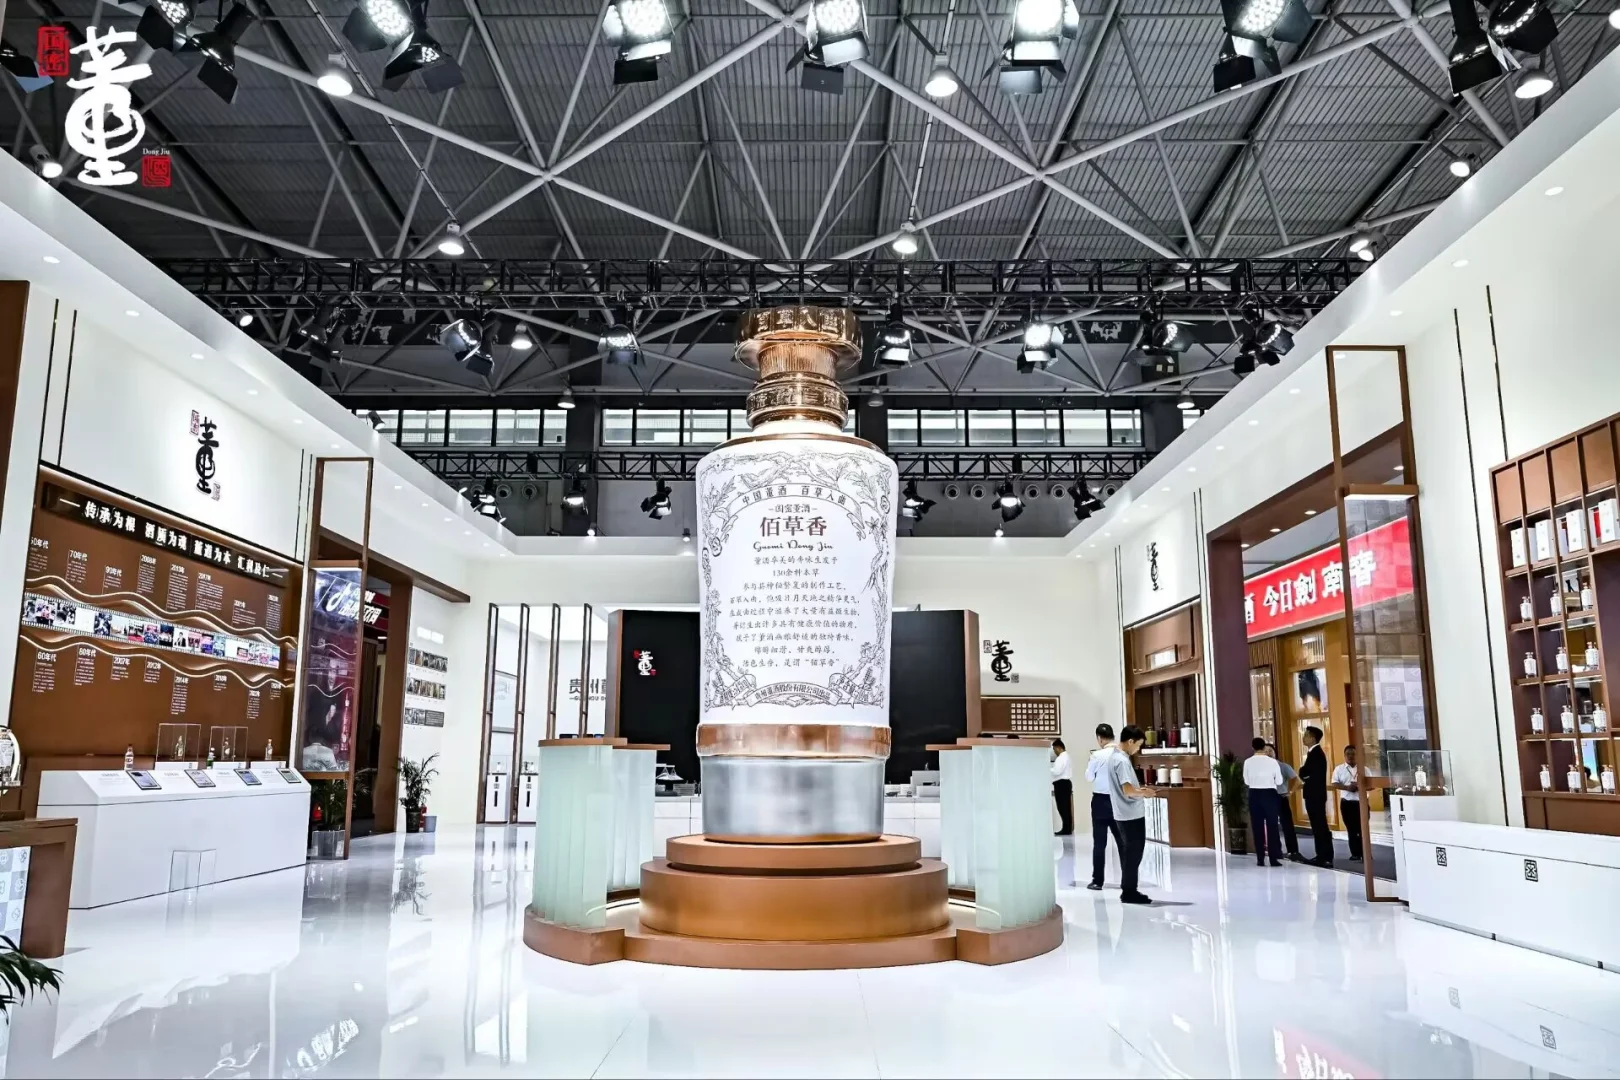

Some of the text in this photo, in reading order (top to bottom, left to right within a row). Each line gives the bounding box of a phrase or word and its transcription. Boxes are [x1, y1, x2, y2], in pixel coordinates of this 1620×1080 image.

[742, 485, 787, 506] 中国董酒
[760, 516, 827, 537] 佰草香
[787, 540, 814, 551] Dong
[817, 541, 834, 551] Jiu
[37, 651, 57, 662] 60年代
[638, 651, 653, 676] 董
[991, 640, 1014, 682] 董
